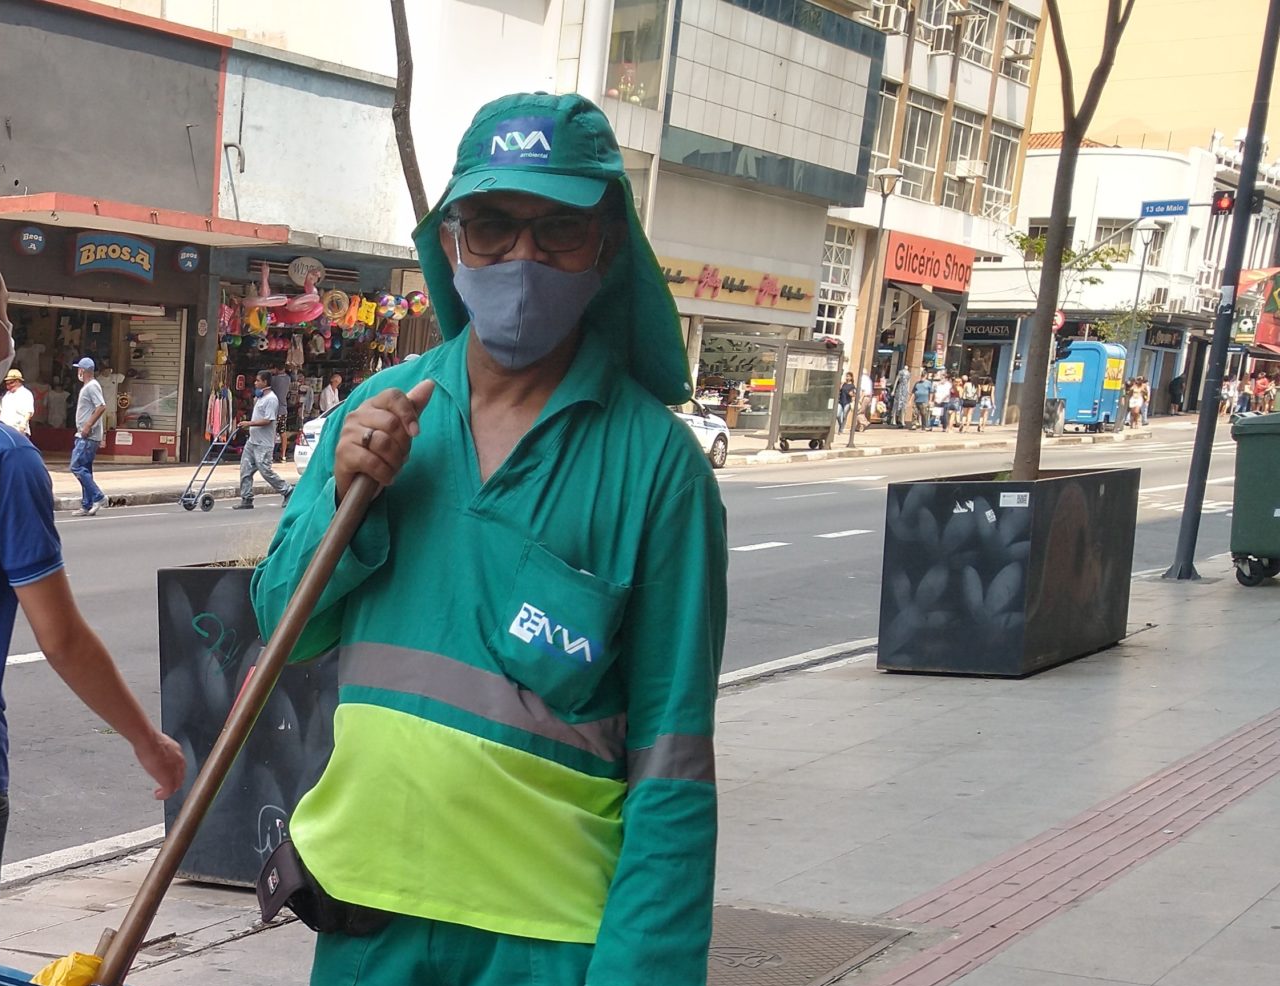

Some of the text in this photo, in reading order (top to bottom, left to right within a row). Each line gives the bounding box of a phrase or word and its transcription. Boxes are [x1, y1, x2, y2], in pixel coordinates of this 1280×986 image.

[520, 151, 548, 159] ambiental
[1145, 205, 1154, 213] 13
[1166, 204, 1184, 212] Maio
[894, 242, 972, 290] Glicério Shop
